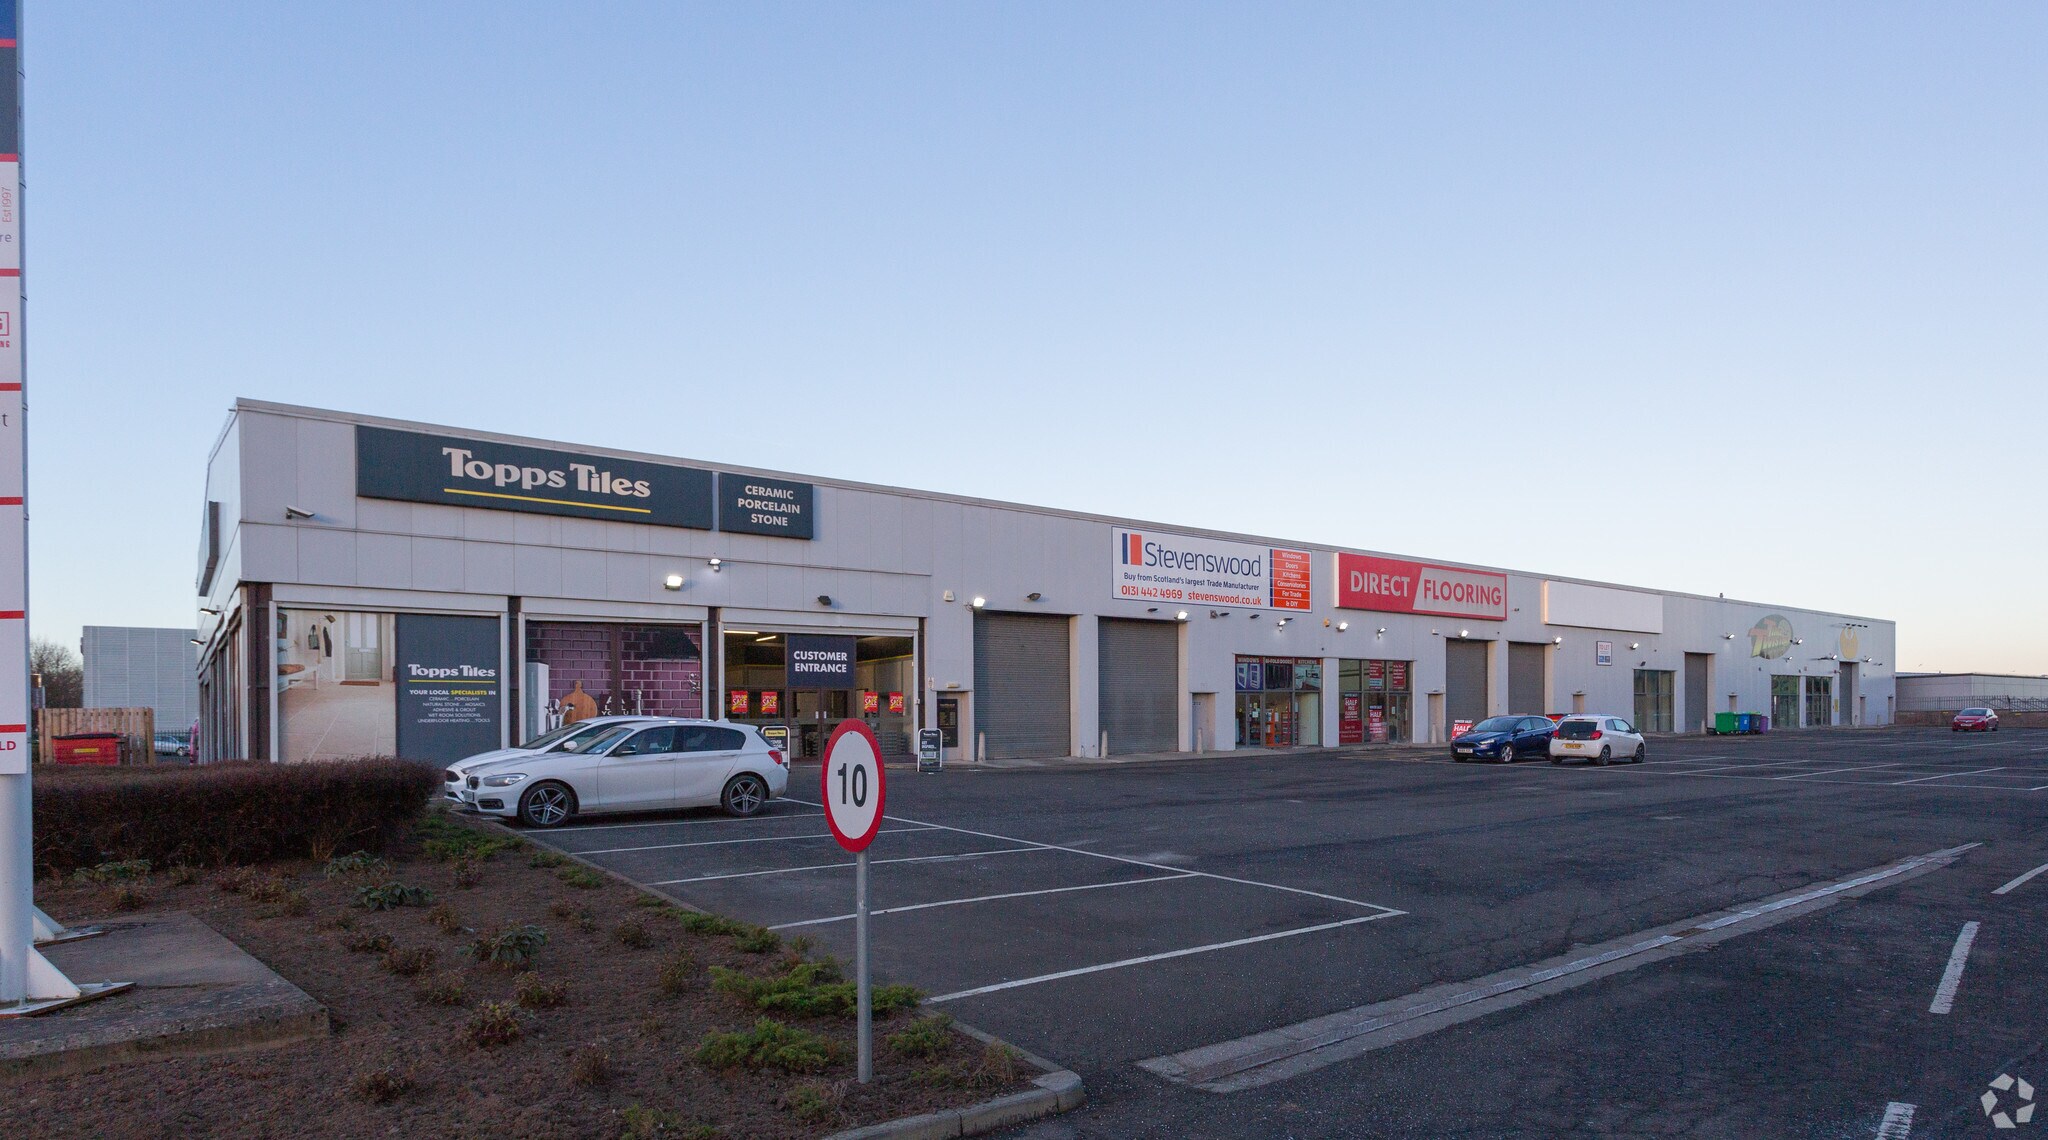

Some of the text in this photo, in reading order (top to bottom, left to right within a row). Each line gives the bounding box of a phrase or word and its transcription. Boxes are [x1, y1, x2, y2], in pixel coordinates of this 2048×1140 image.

[442, 447, 651, 498] Topps Tiles
[744, 485, 794, 500] CERAMIC
[738, 498, 800, 514] PORCELAIN
[751, 514, 788, 526] STONE
[1145, 542, 1261, 578] Stevenswood
[1124, 572, 1260, 591] Buy from Scotland's largest Trade Manufacturer
[1350, 570, 1502, 606] DIRECT FLOORING
[1121, 585, 1262, 606] 0131 442 4969 stevenswood.co.uk
[793, 650, 848, 661] CUSTOMER
[408, 664, 496, 678] Topps Tiles
[794, 662, 847, 673] ENTRANCE
[838, 762, 868, 808] 10
